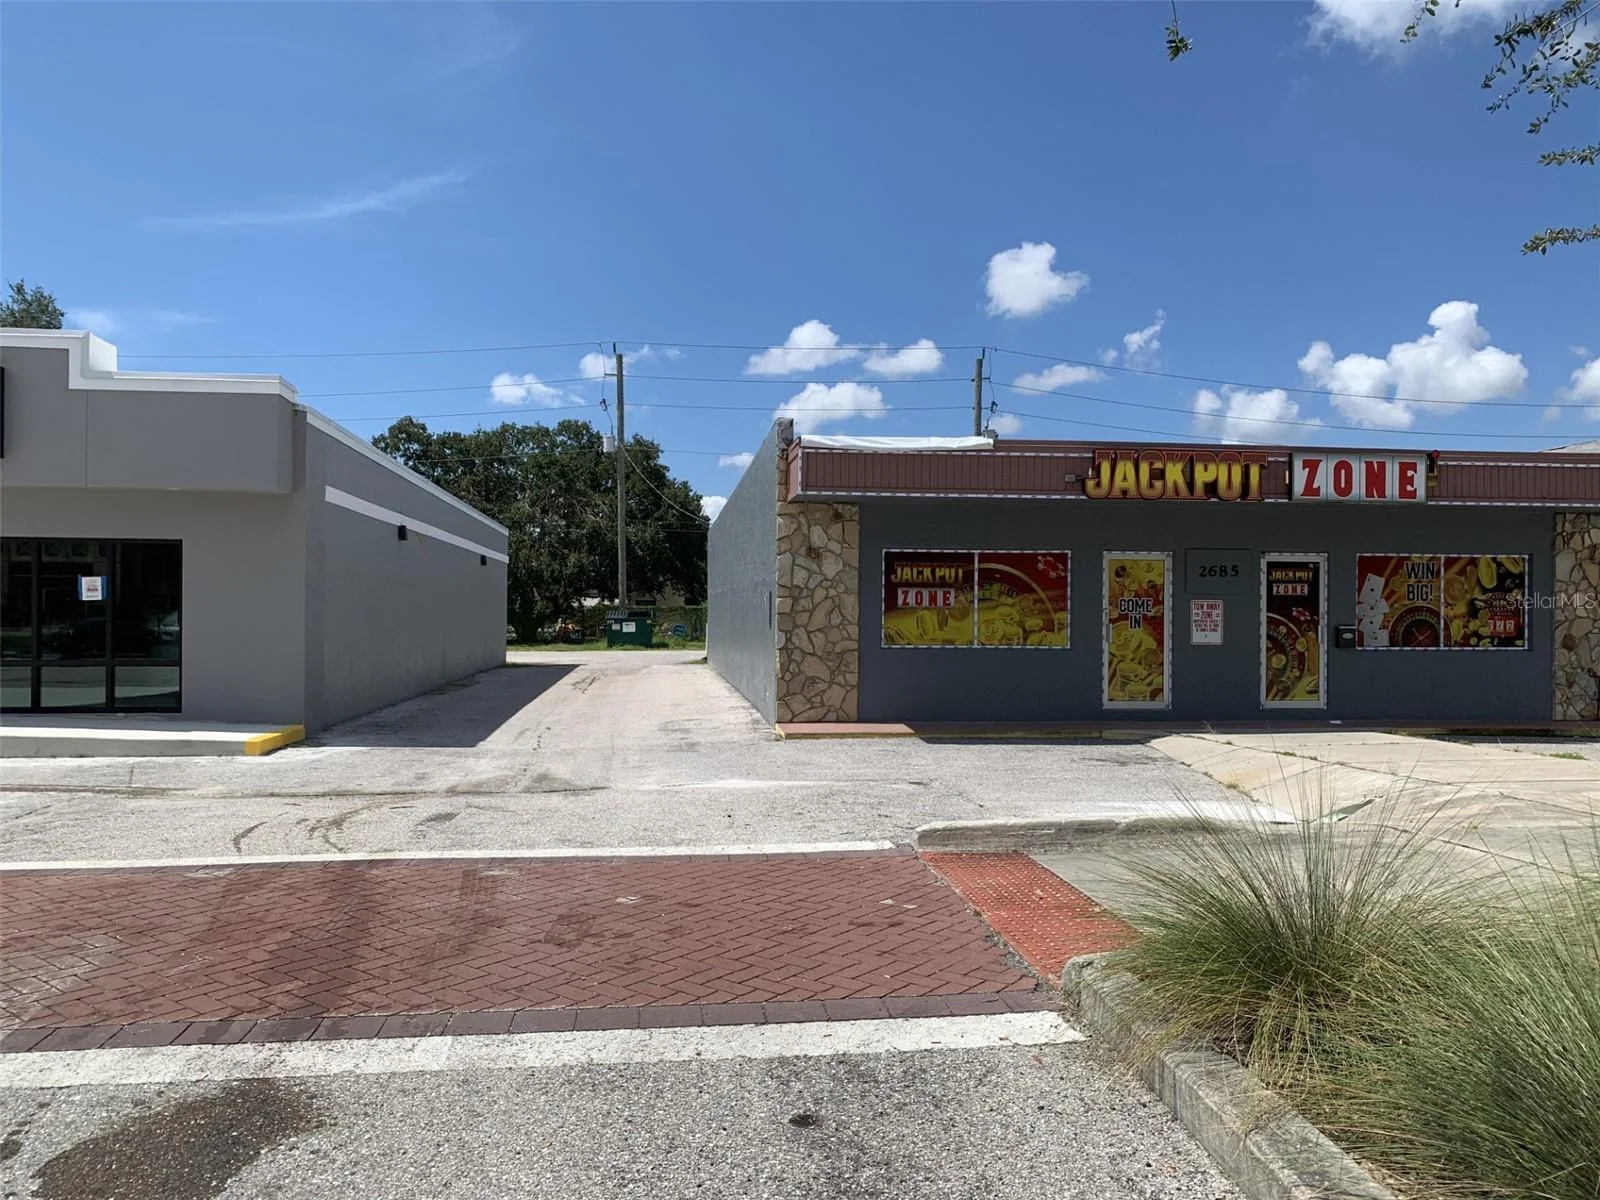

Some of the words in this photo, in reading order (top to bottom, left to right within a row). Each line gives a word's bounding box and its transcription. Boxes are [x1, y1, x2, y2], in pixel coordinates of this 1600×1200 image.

[1085, 450, 1267, 501] JACKPOT
[1302, 458, 1418, 499] ZONE
[891, 563, 964, 583] JACKPOT
[1199, 565, 1239, 578] 2685
[1406, 562, 1435, 580] WIN
[1275, 584, 1306, 595] ZONE
[1406, 584, 1433, 602] BIG!
[901, 590, 953, 607] ZONE
[1119, 598, 1153, 614] COME
[1193, 602, 1205, 611] TOW
[1206, 602, 1221, 611] AWAY
[1129, 616, 1141, 629] IN
[1200, 611, 1214, 619] ZONE
